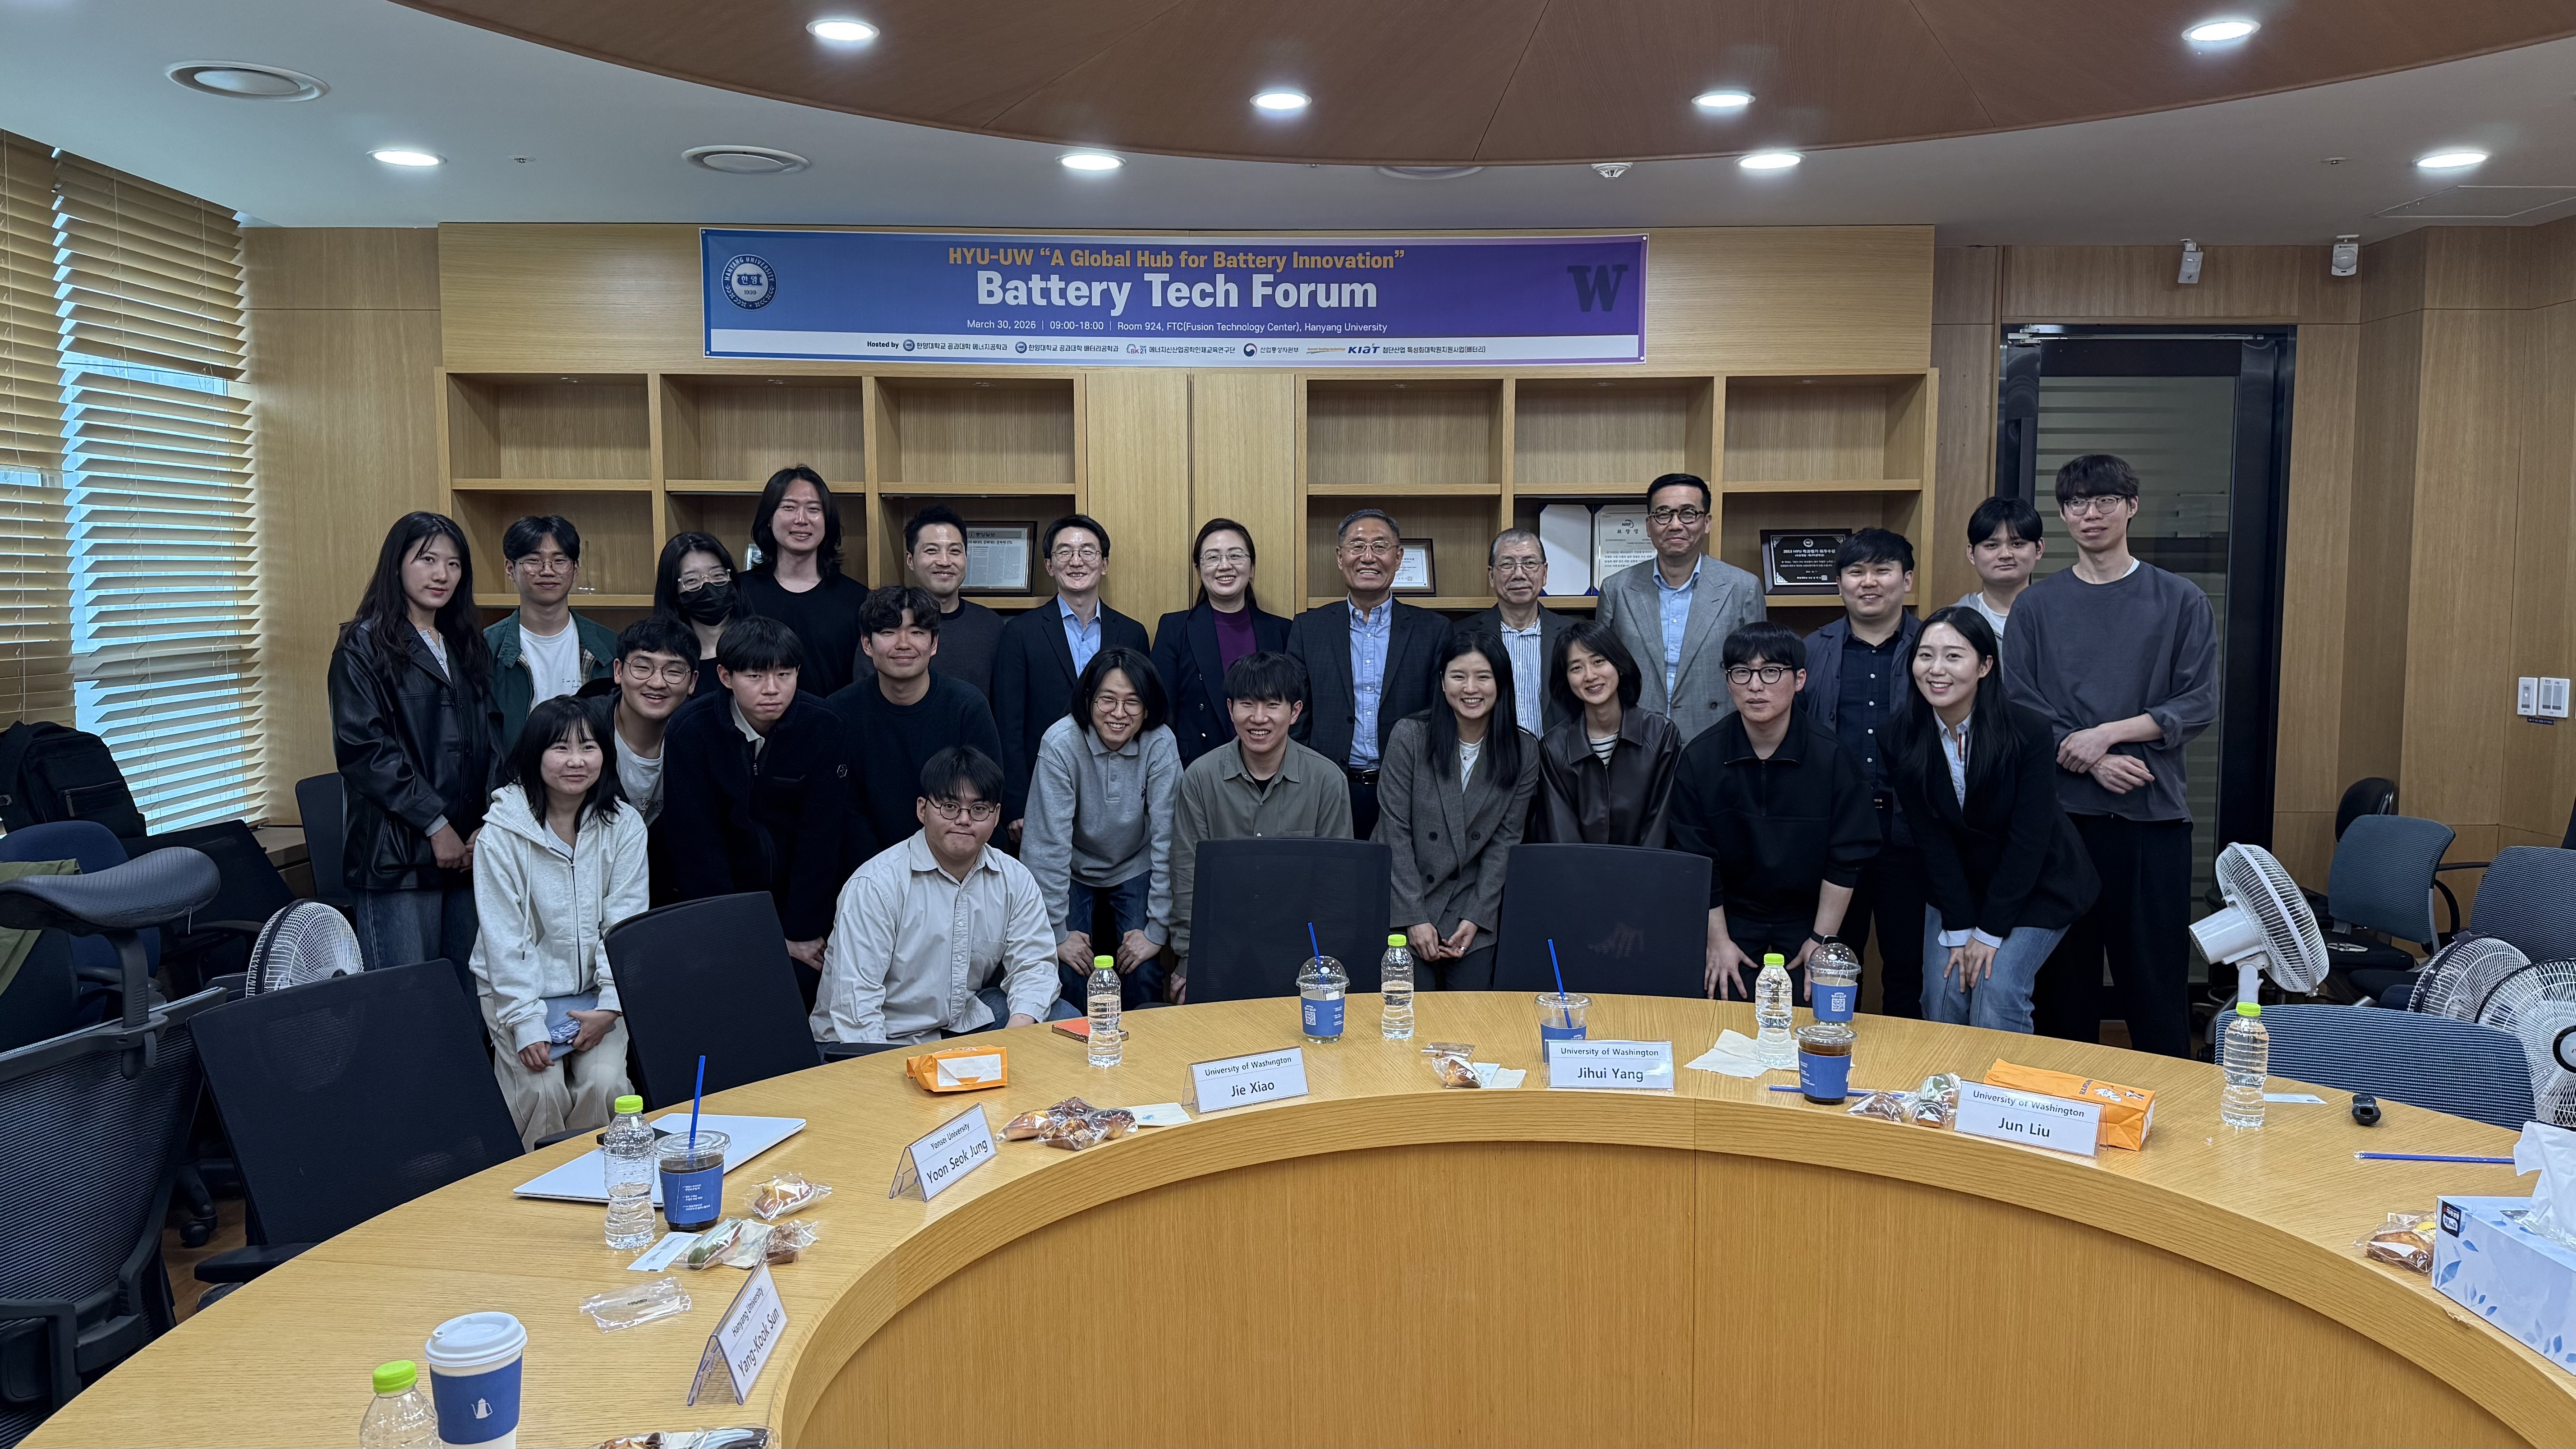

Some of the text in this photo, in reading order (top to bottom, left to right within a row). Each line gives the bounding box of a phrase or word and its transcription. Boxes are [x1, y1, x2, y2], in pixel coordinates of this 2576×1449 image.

[724, 257, 774, 281] HANYANG UNIVERSITY
[949, 248, 1404, 272] HYU-UW “A Global Hub for Battery Innovation”
[977, 271, 1377, 316] Battery Tech Forum
[1567, 264, 1628, 312] W
[967, 320, 1387, 333] March 30, 2026 09:00-18:00 Room 924, FTC(Fusion Technology Center), Hanyang University
[1561, 1048, 1599, 1057] University
[1612, 1049, 1659, 1057] Washington
[1205, 1065, 1239, 1076] University
[1251, 1057, 1292, 1068] Washington
[1578, 1067, 1643, 1082] Jihui Yang
[1231, 1081, 1274, 1097] Jie Xiao
[1973, 1090, 2016, 1106] University
[2031, 1100, 2084, 1117] Washington
[930, 1123, 970, 1150] Yonsei University
[1998, 1117, 2050, 1137] Jun Liu
[927, 1140, 988, 1183] Yoon Seok Jung
[732, 1286, 764, 1337] Hanyang University
[738, 1308, 779, 1376] Yang-Kook Sun
